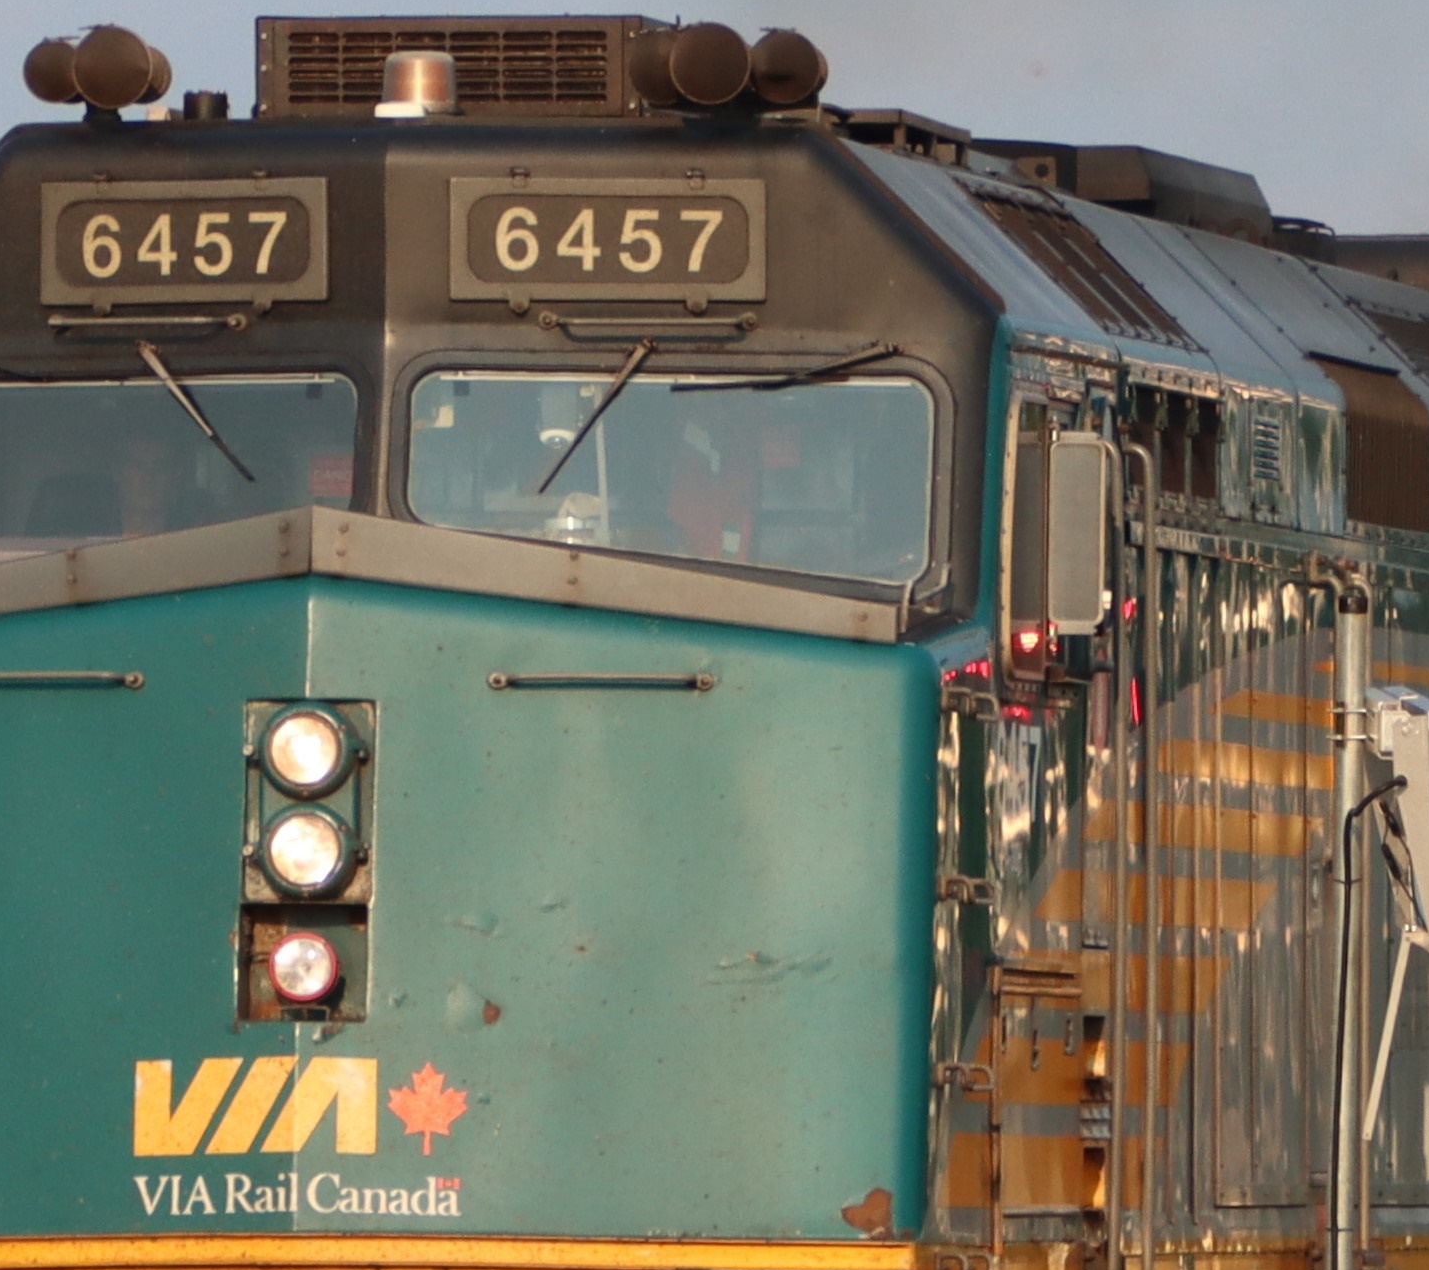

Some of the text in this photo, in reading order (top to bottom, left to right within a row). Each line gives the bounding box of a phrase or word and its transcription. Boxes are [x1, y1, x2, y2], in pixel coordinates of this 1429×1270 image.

[82, 212, 287, 278] 6457
[495, 206, 723, 273] 6457
[134, 1055, 377, 1156] VIA
[134, 1173, 462, 1217] VIA Rail Canada
